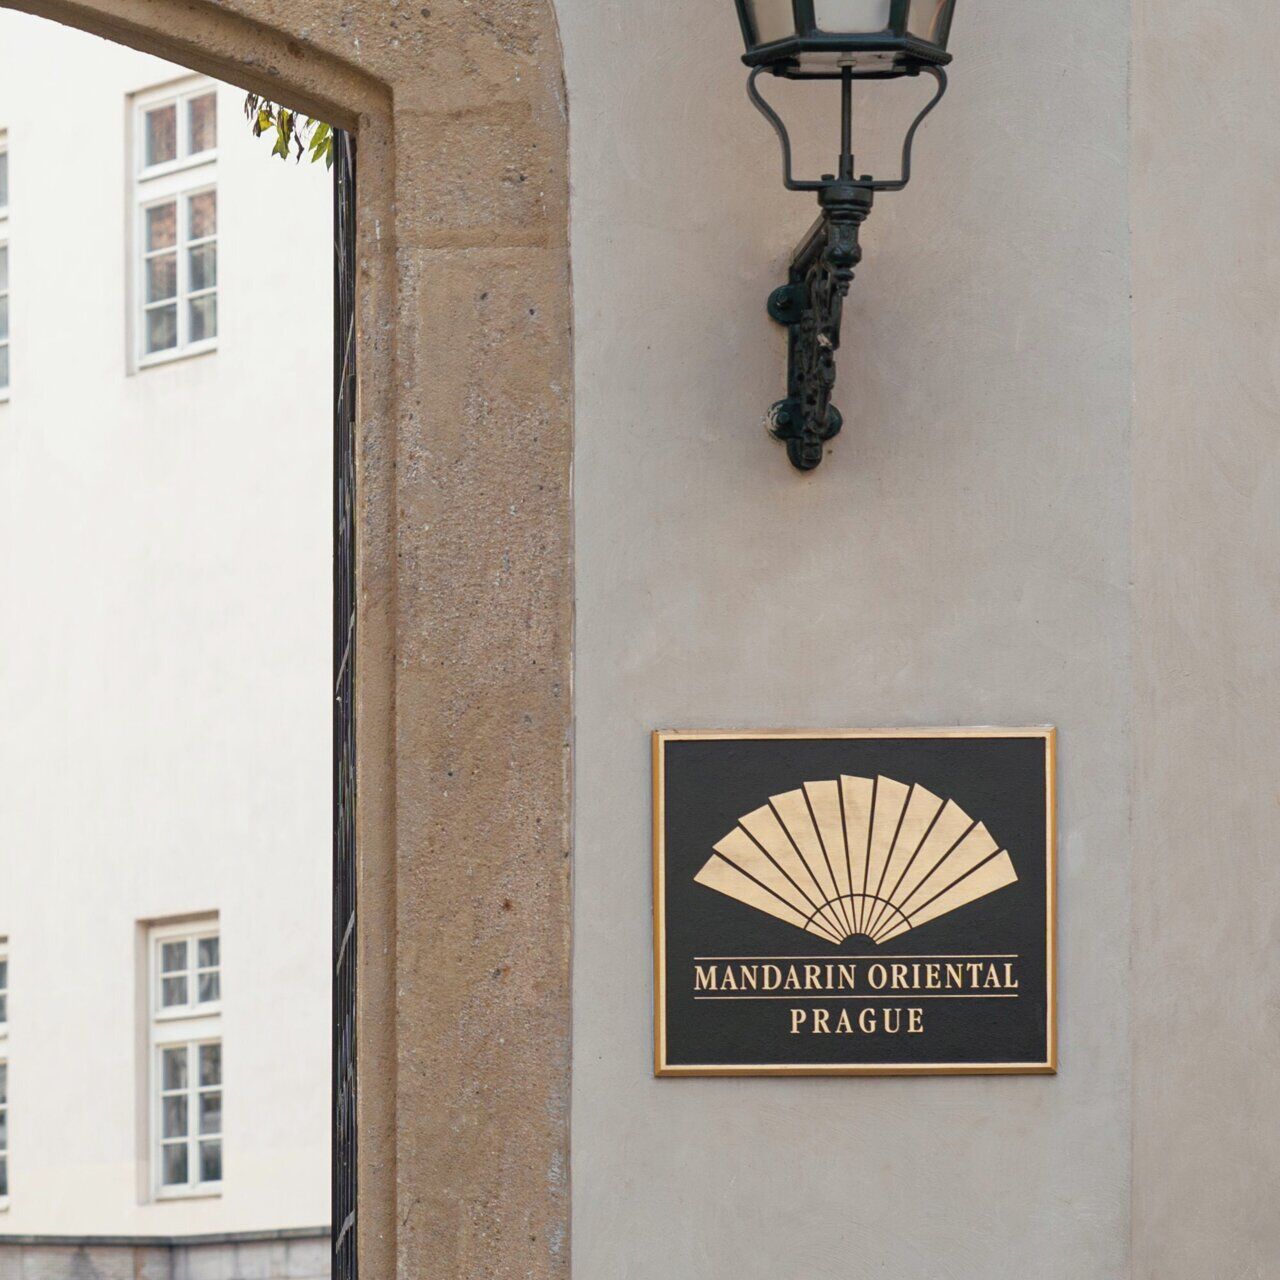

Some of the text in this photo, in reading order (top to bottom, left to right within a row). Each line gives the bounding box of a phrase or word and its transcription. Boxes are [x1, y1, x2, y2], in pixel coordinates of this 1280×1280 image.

[693, 962, 1019, 991] MANDARIN ORIENTAL
[789, 1007, 925, 1034] PRAGUE
